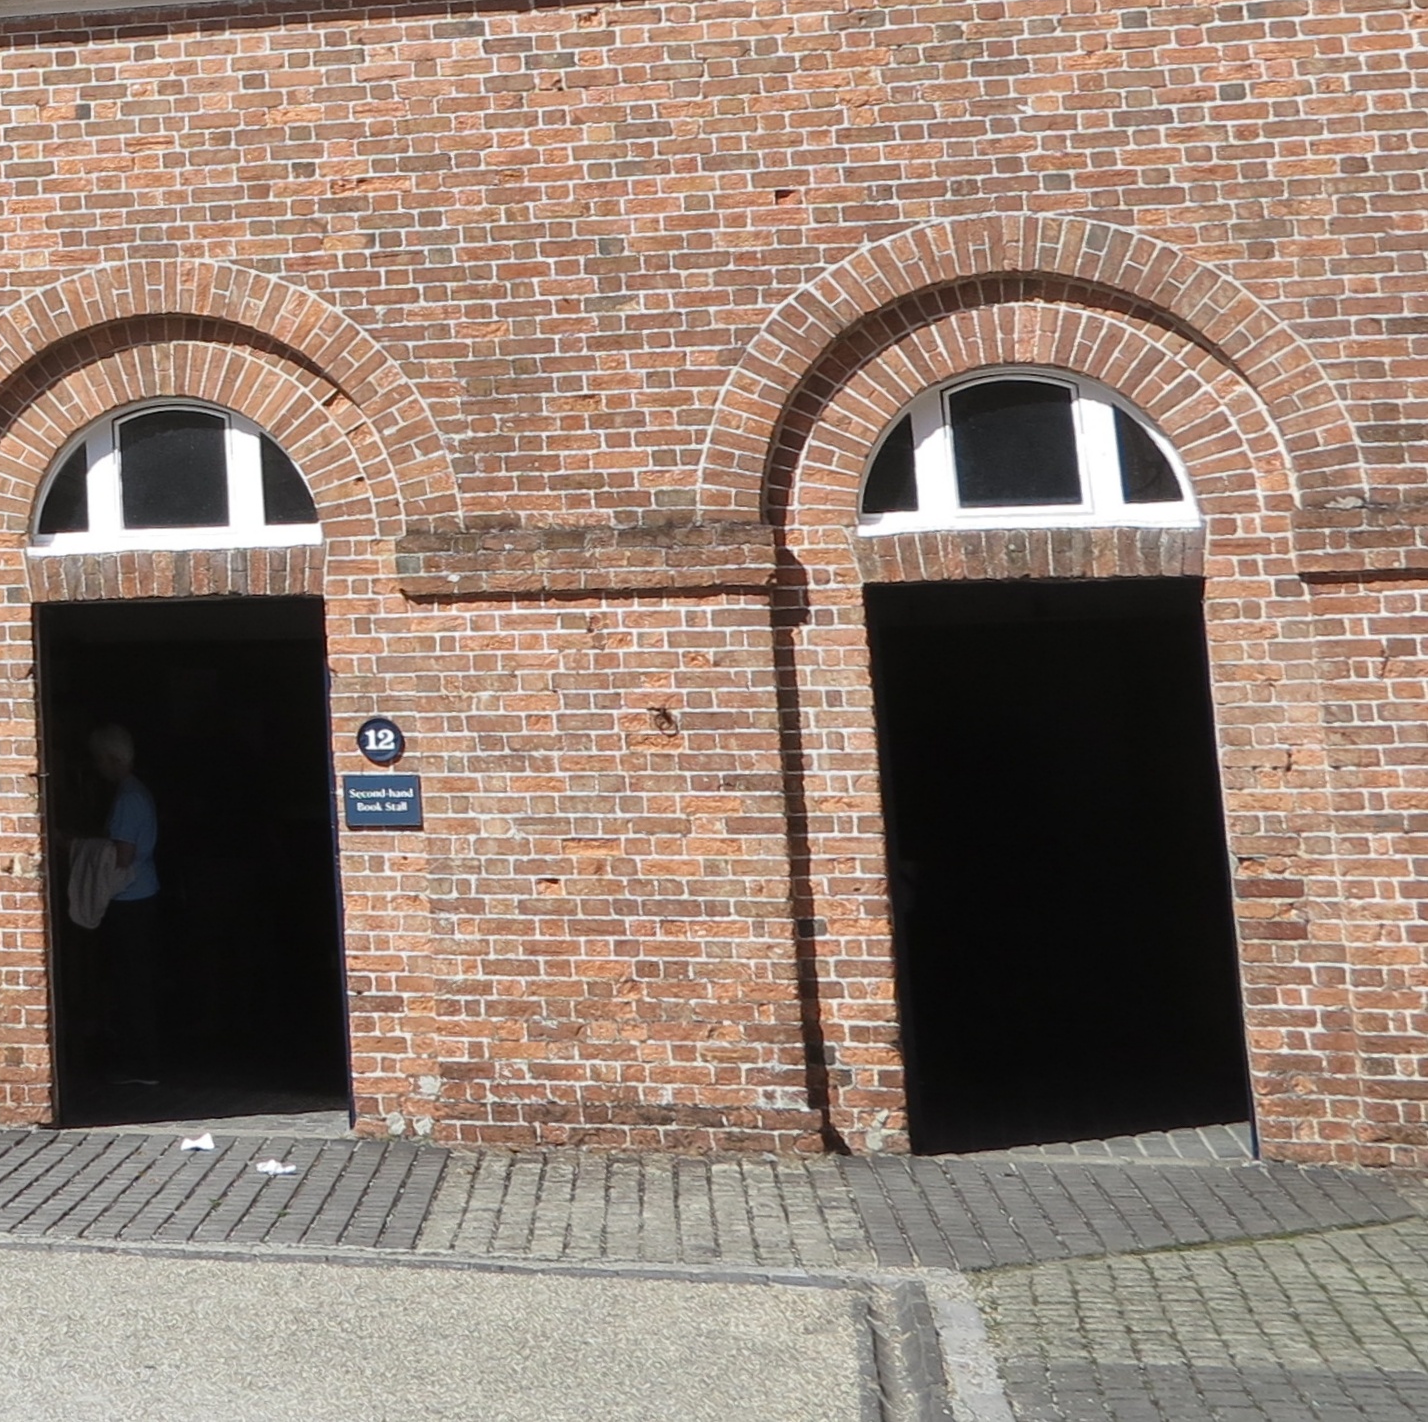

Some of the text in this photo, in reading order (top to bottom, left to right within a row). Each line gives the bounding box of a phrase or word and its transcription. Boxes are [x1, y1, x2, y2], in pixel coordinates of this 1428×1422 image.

[364, 729, 395, 750] 12
[348, 788, 414, 799] Second-hand
[356, 802, 408, 812] Book Stall
